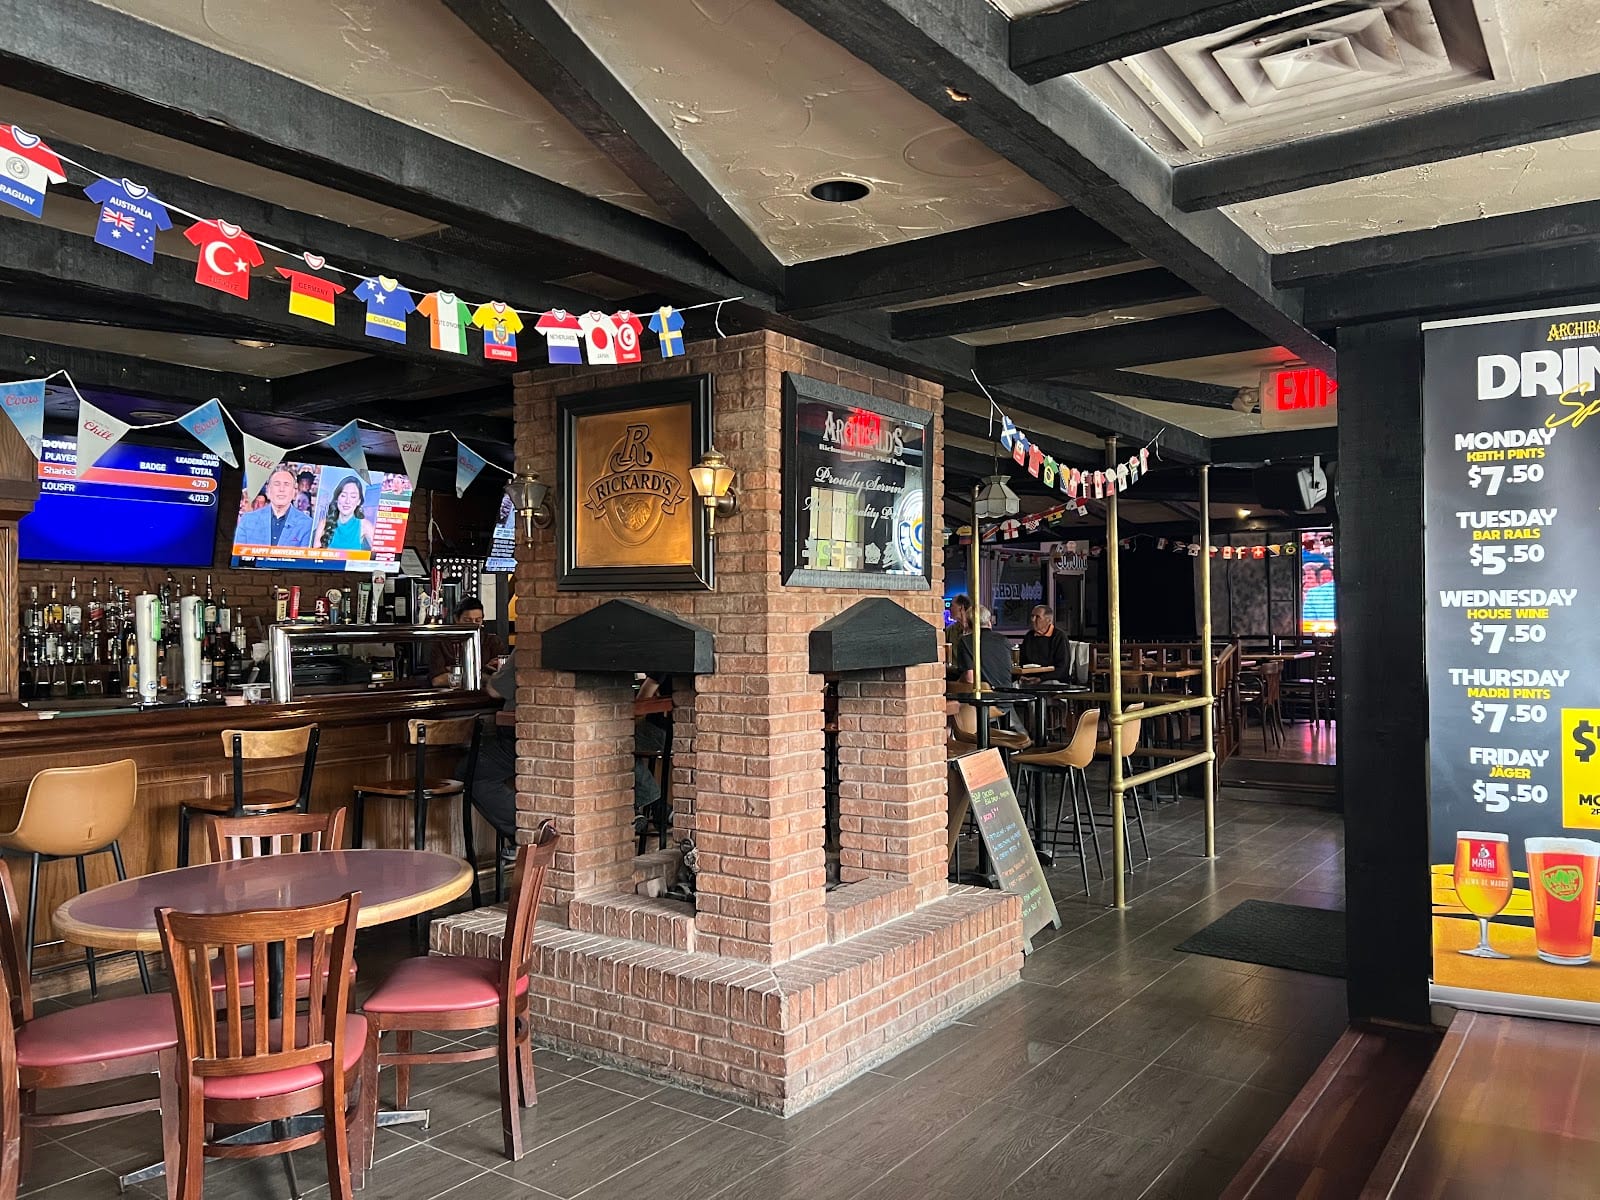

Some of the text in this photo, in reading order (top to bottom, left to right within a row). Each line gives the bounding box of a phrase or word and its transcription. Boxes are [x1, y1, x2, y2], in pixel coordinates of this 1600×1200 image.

[109, 196, 153, 220] AUSTRALIA
[298, 282, 329, 296] GERMANY
[1277, 368, 1327, 411] EXIT
[6, 393, 39, 407] Coors
[83, 420, 115, 441] Chill
[193, 416, 220, 435] Coors
[402, 443, 422, 453] Chill
[610, 424, 653, 473] R
[1454, 427, 1557, 452] MONDAY
[44, 452, 214, 476] PLAYER BADGE TOTAL
[176, 456, 220, 467] LEADERBOARD
[202, 453, 220, 461] FINAL
[249, 454, 275, 470] Chill
[1466, 447, 1546, 463] KEITH PINTS
[595, 473, 673, 500] RICKARD'S
[814, 466, 865, 501] Proudly
[1468, 463, 1545, 496] $7.50
[1455, 508, 1558, 529] TUESDAY
[1472, 528, 1541, 541] BAR RAILS
[1469, 543, 1545, 576] $5.50
[1439, 588, 1578, 608] WEDNESDAY
[1467, 608, 1549, 620] HOUSE WINE
[1469, 621, 1547, 654] $7.50
[1448, 668, 1570, 687] THURSDAY
[1467, 687, 1551, 700] MADRI PINTS
[1471, 700, 1548, 733] $7.50
[1469, 747, 1550, 767] FRIDAY
[1489, 764, 1531, 780] JÄGER
[1472, 779, 1548, 813] $5.50
